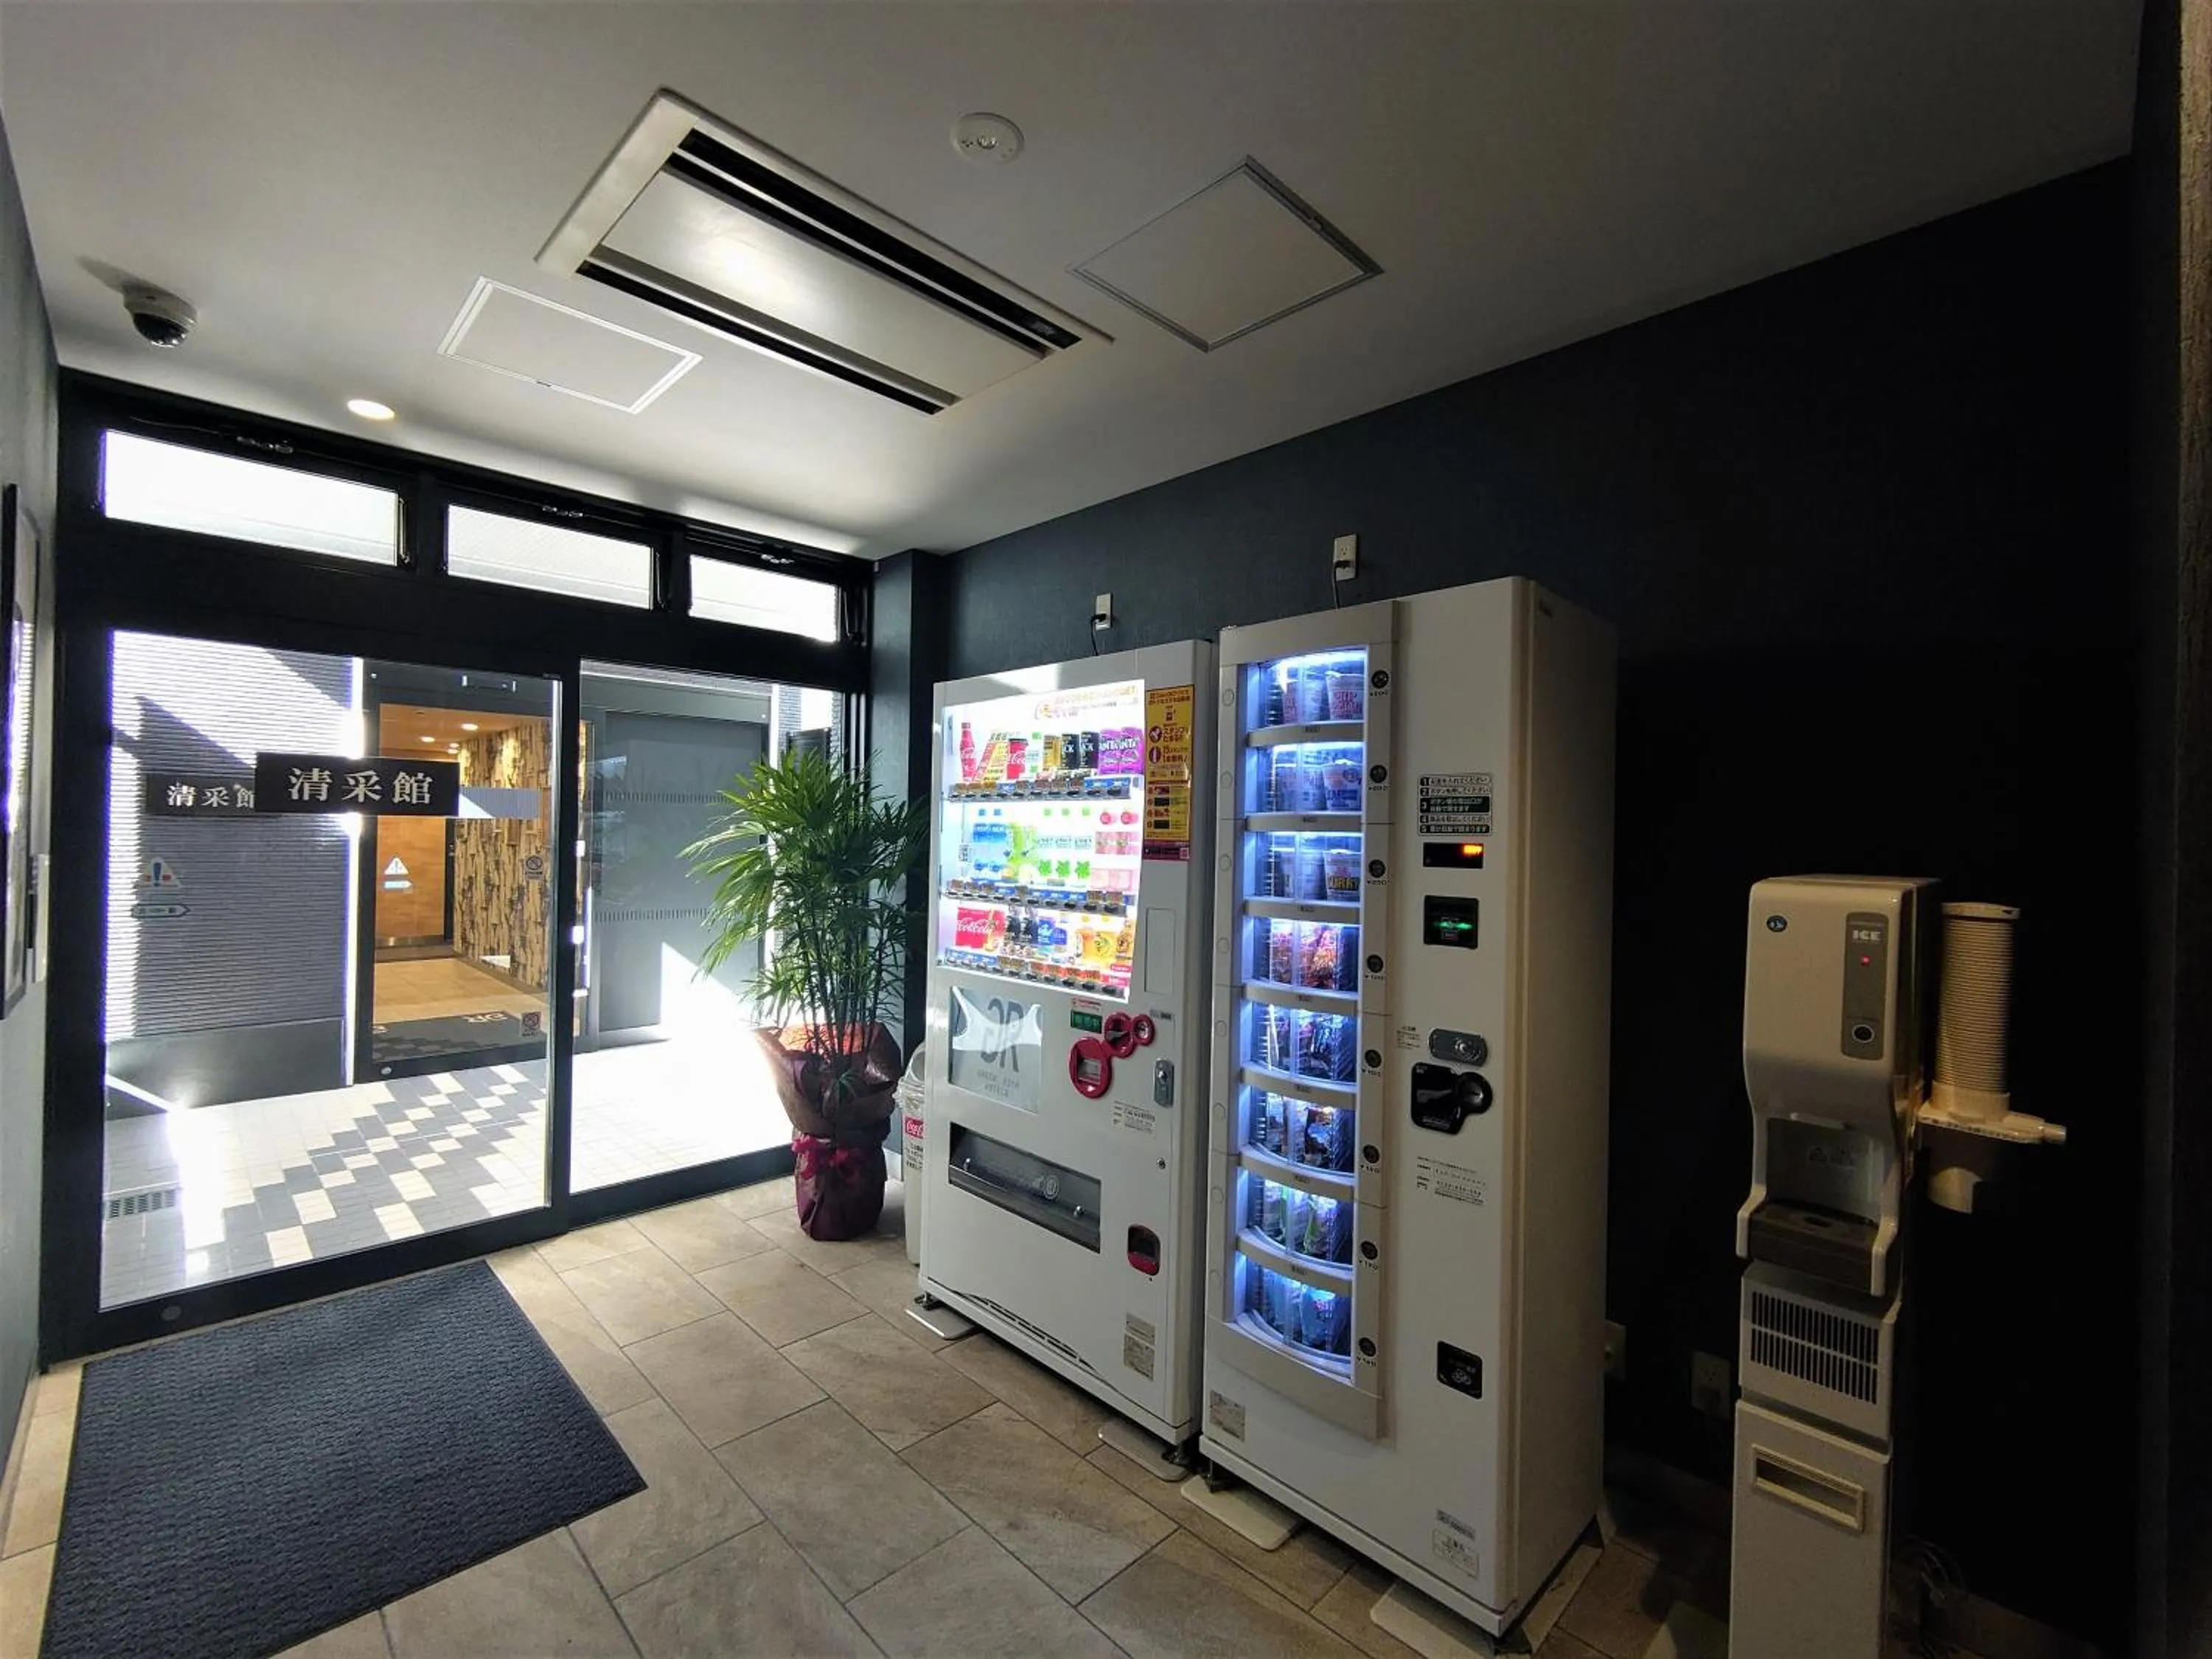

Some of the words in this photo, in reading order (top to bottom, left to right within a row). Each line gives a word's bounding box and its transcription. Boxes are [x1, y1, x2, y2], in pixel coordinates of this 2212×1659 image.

[288, 767, 434, 805] 清采館
[1852, 930, 1881, 941] ICE
